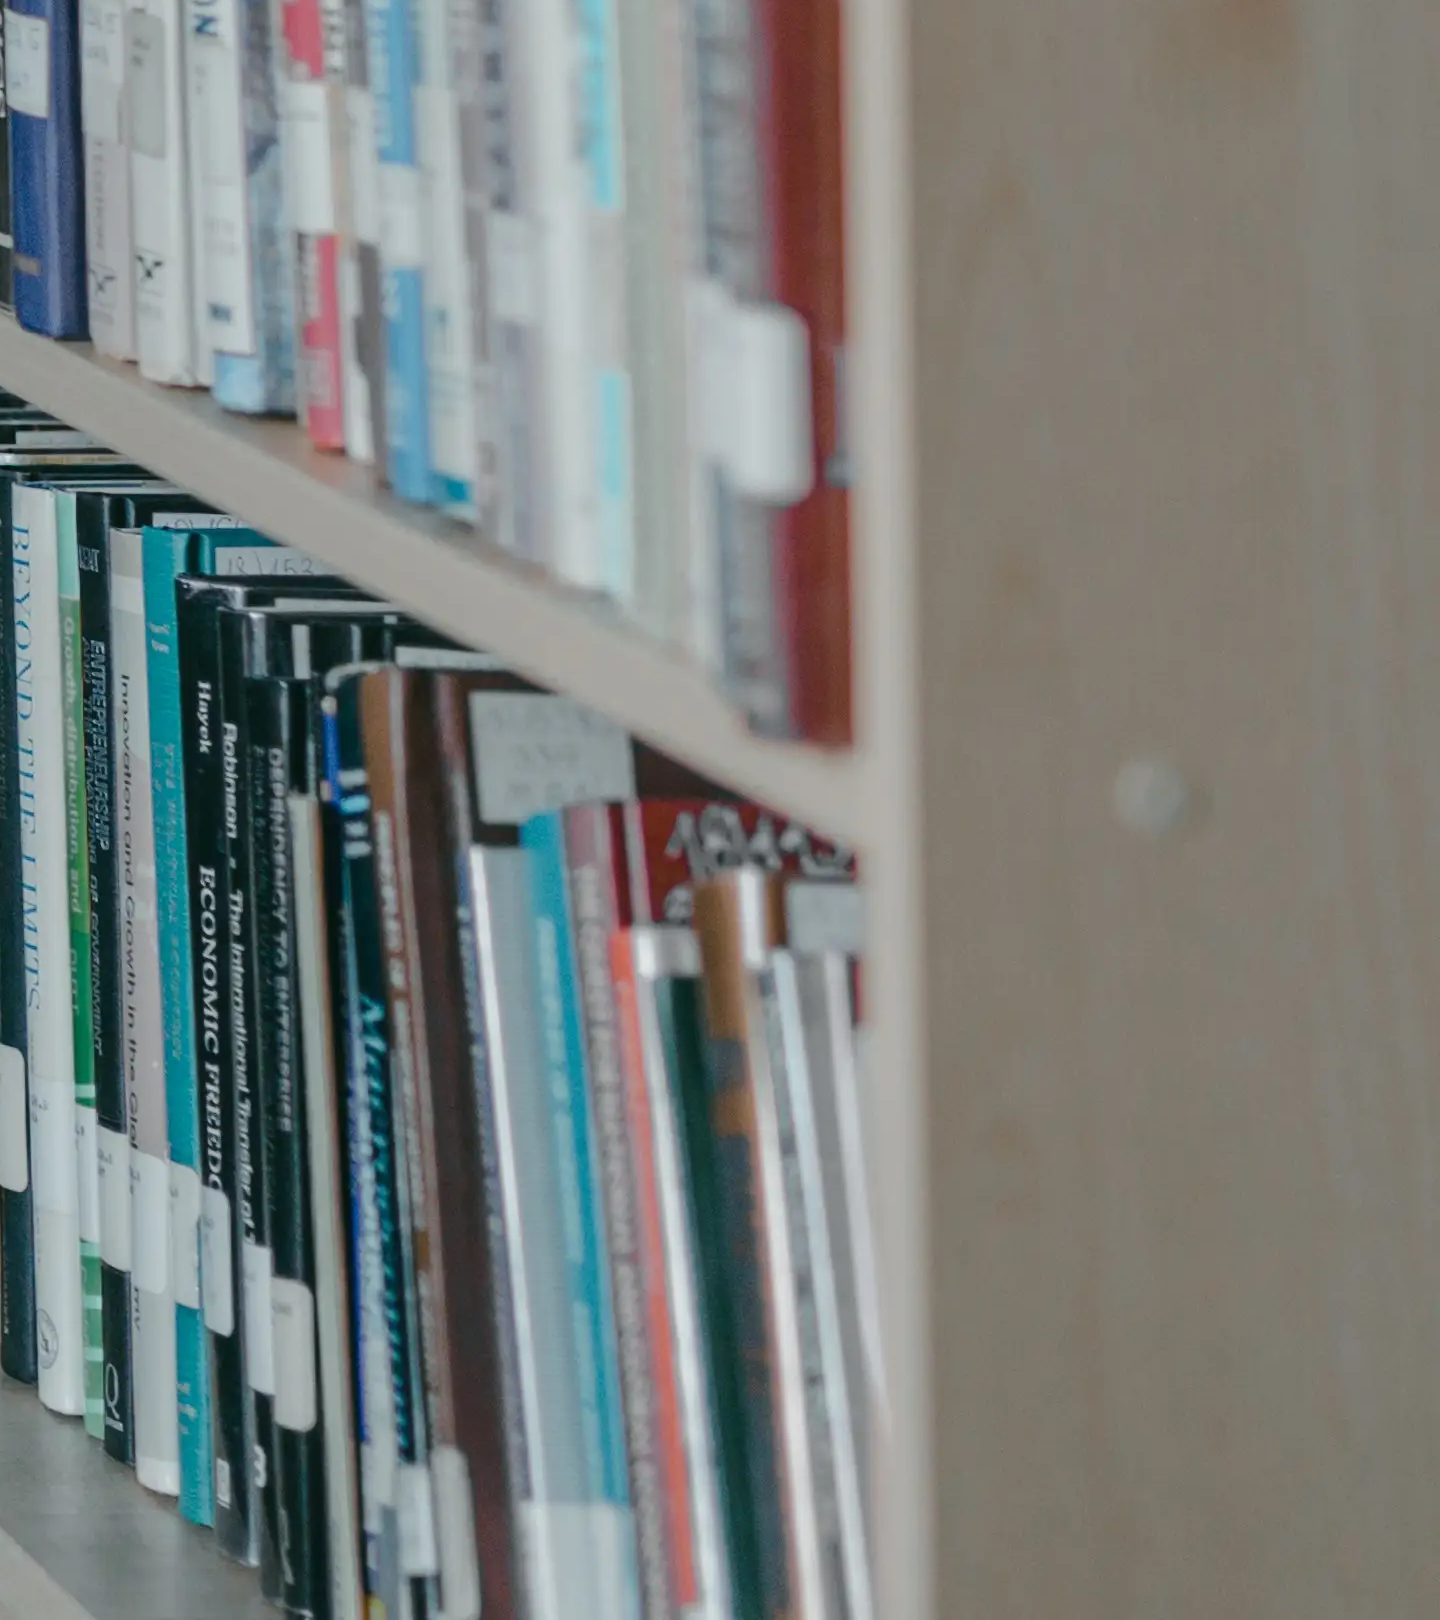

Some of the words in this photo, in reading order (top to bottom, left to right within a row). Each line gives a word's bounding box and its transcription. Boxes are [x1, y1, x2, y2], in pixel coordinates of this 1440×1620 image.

[11, 523, 33, 722] BEYOND
[90, 640, 110, 853] ENTREPRENEURSHIP
[120, 674, 130, 821] Innovation
[197, 681, 213, 755] Hayek
[15, 738, 37, 836] THE
[222, 721, 238, 840] Robinson
[69, 867, 82, 913] and
[122, 831, 132, 887] and
[24, 856, 41, 1013] LIMITS
[123, 895, 134, 993] Growth
[198, 865, 221, 1054] ECONOMIC
[229, 888, 244, 935] The
[126, 1002, 136, 1028] in
[128, 1038, 138, 1084] the
[232, 939, 249, 1094] International
[236, 1098, 253, 1195] Transfer
